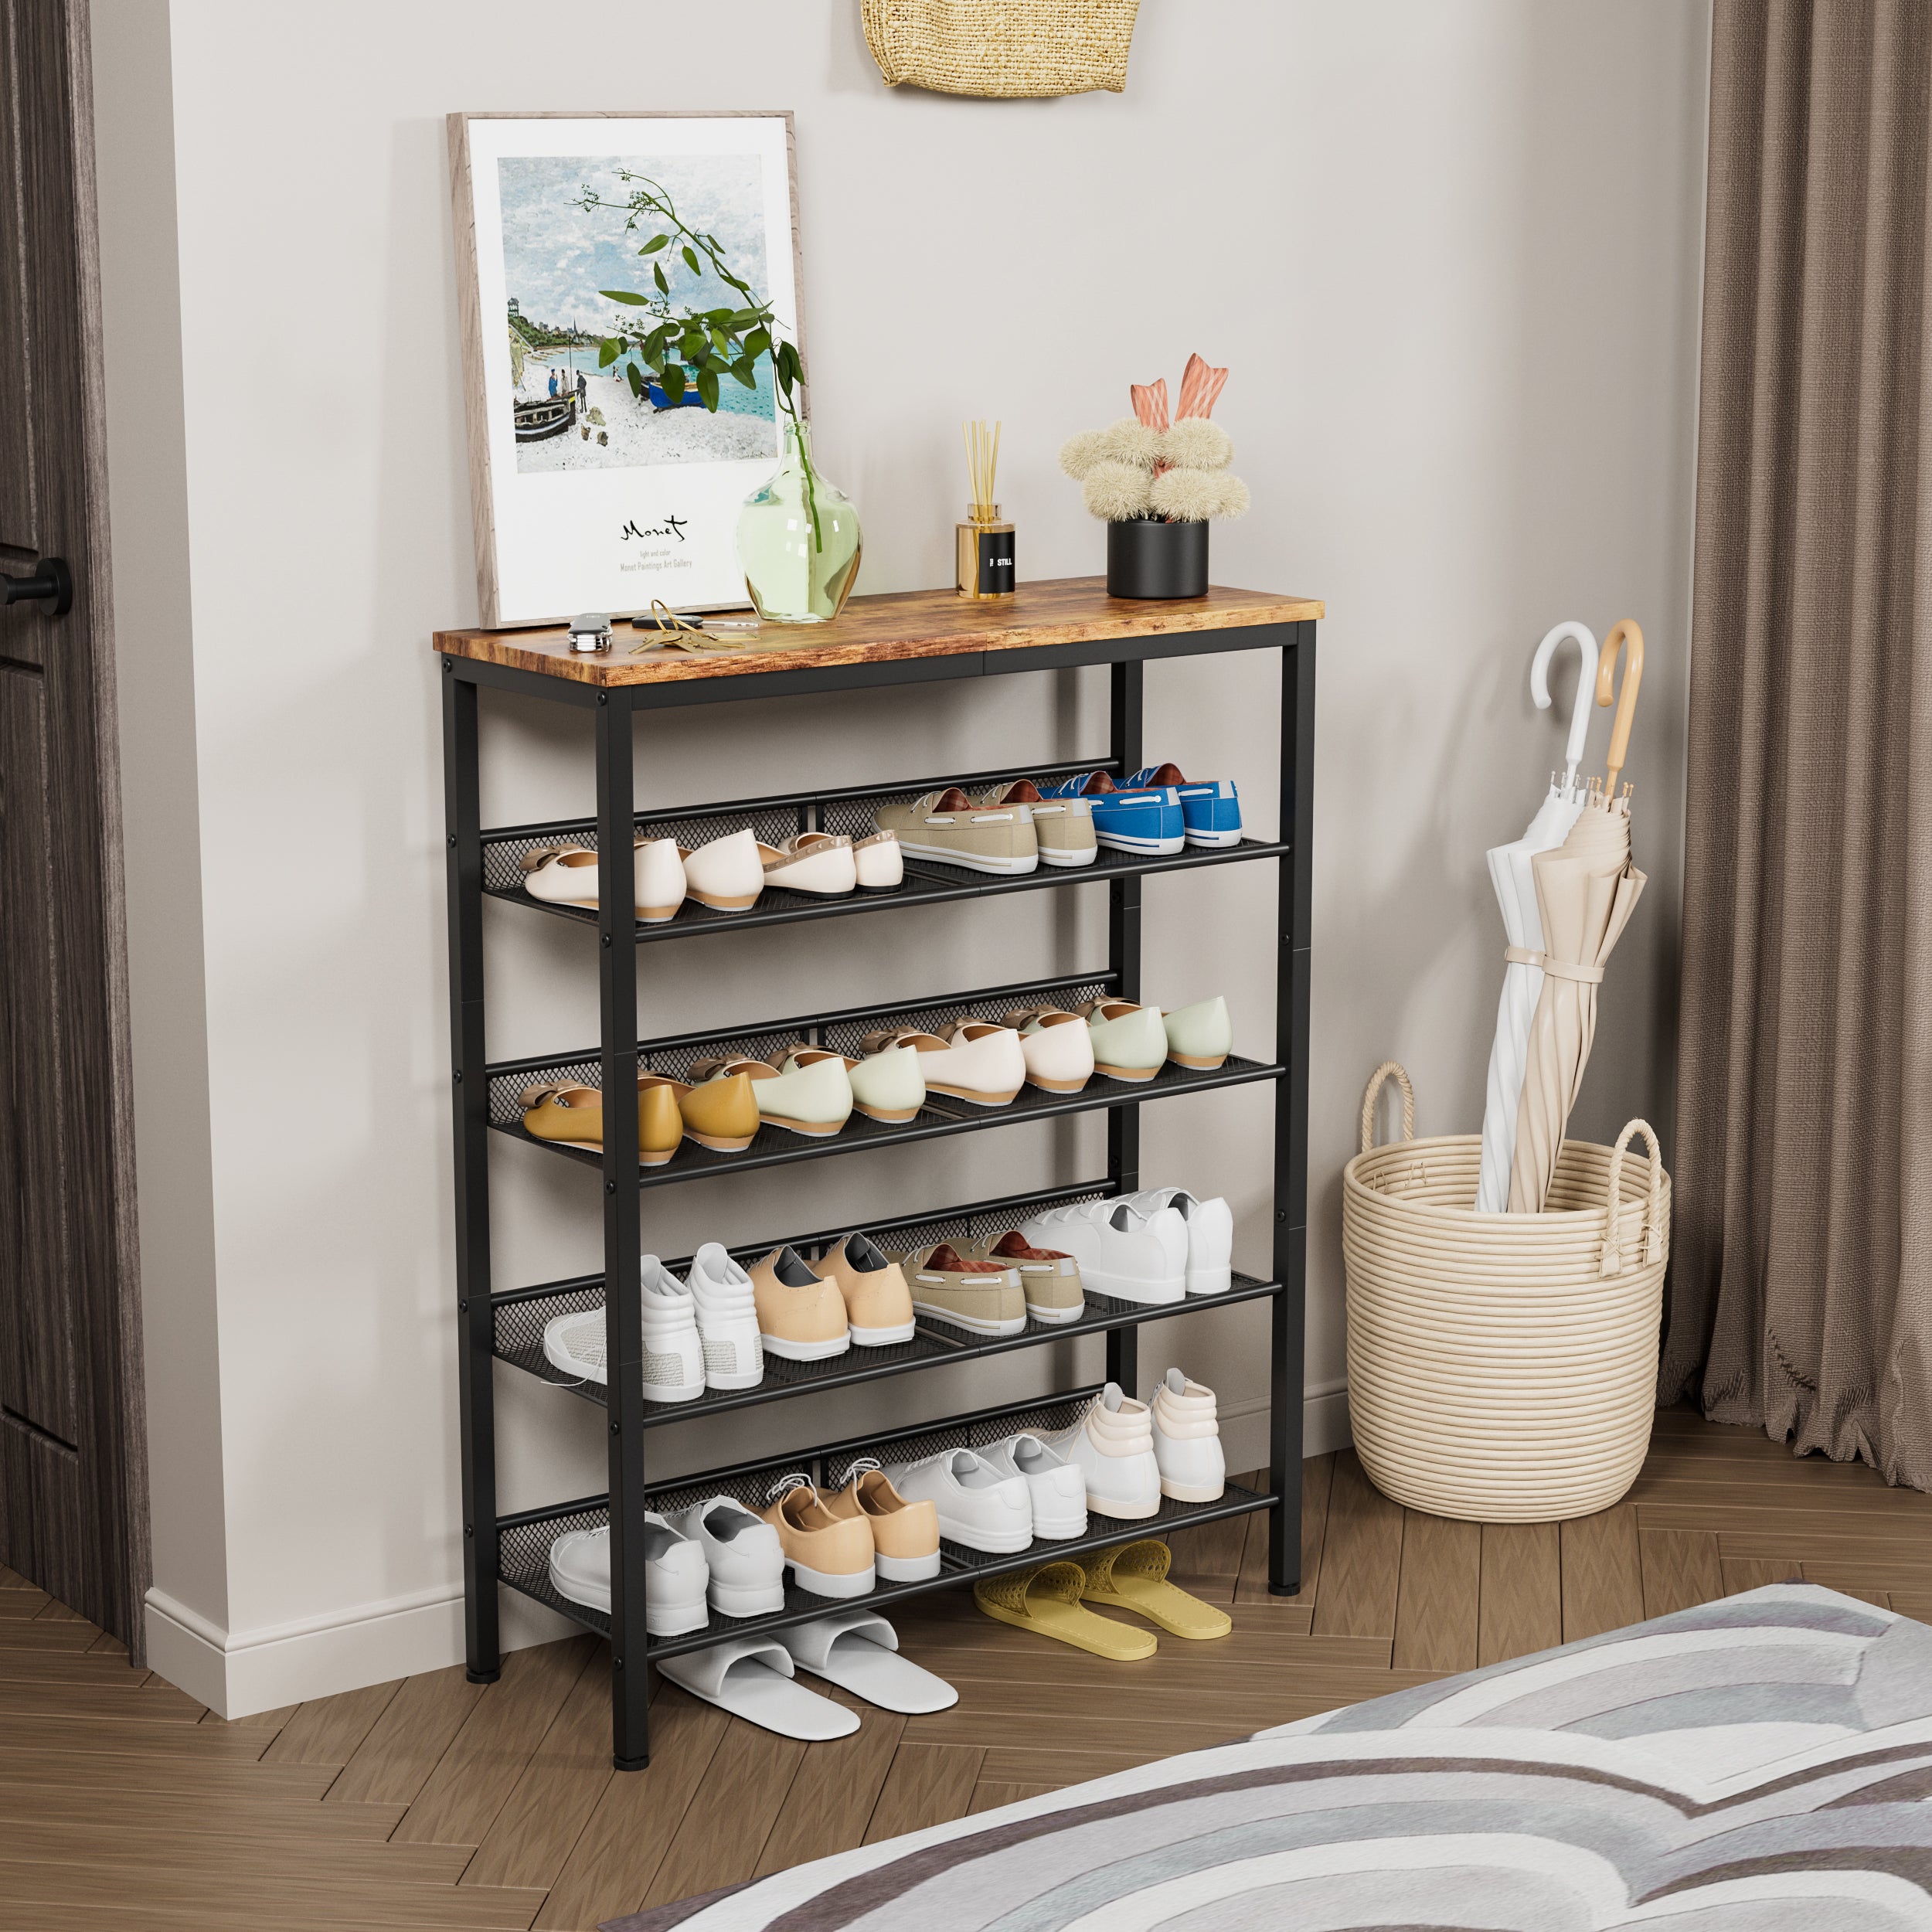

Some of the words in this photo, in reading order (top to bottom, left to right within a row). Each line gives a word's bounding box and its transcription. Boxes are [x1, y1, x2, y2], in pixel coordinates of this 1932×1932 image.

[621, 515, 688, 542] Monet
[640, 550, 650, 559] light
[620, 563, 636, 572] Monet
[638, 561, 662, 571] Paintings
[664, 560, 672, 569] Art
[673, 559, 692, 569] Gallery
[997, 557, 1012, 566] STILL
